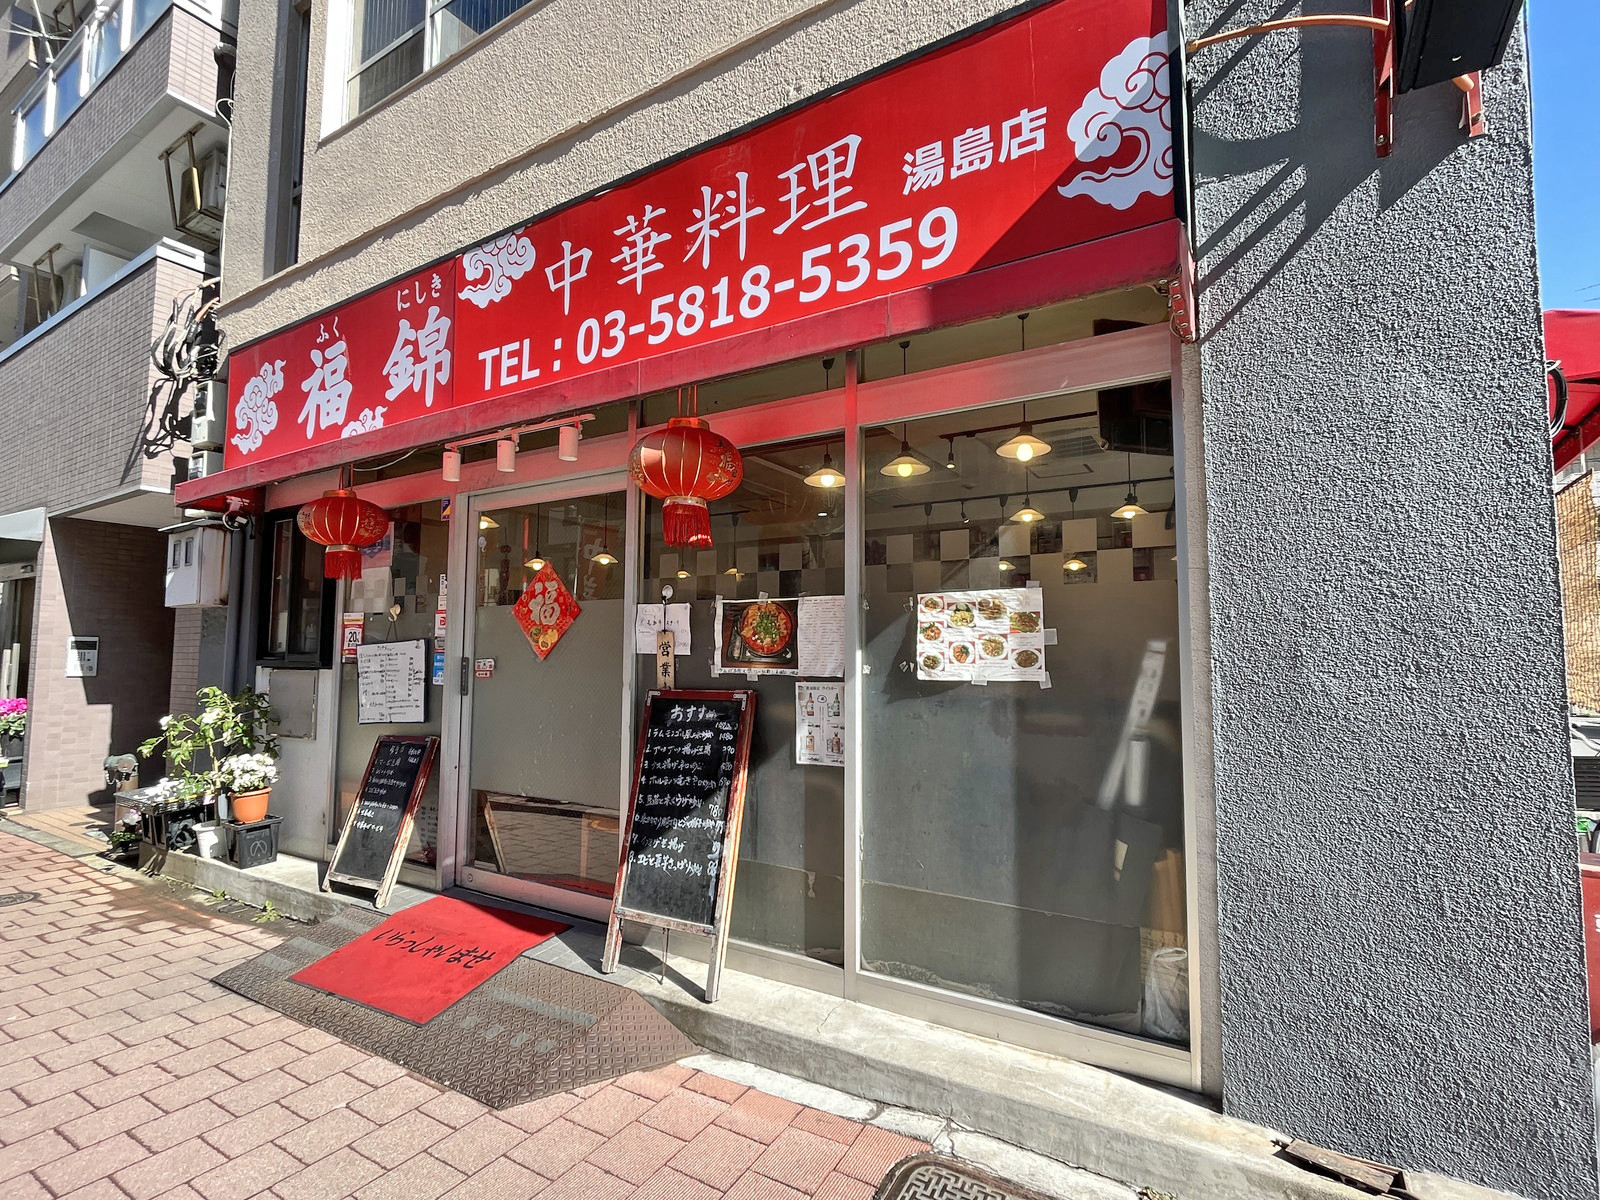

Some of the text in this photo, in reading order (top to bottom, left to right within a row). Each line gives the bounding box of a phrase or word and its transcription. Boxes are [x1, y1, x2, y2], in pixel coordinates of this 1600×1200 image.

[901, 106, 1048, 195] 湯島店
[544, 133, 868, 316] 中華料理
[396, 272, 442, 312] にしき
[576, 206, 958, 365] 03-5818-5359
[316, 315, 340, 343] ふく
[297, 305, 451, 440] 福錦
[658, 640, 672, 690] 営業
[372, 928, 497, 969] いらっしゃいませ
